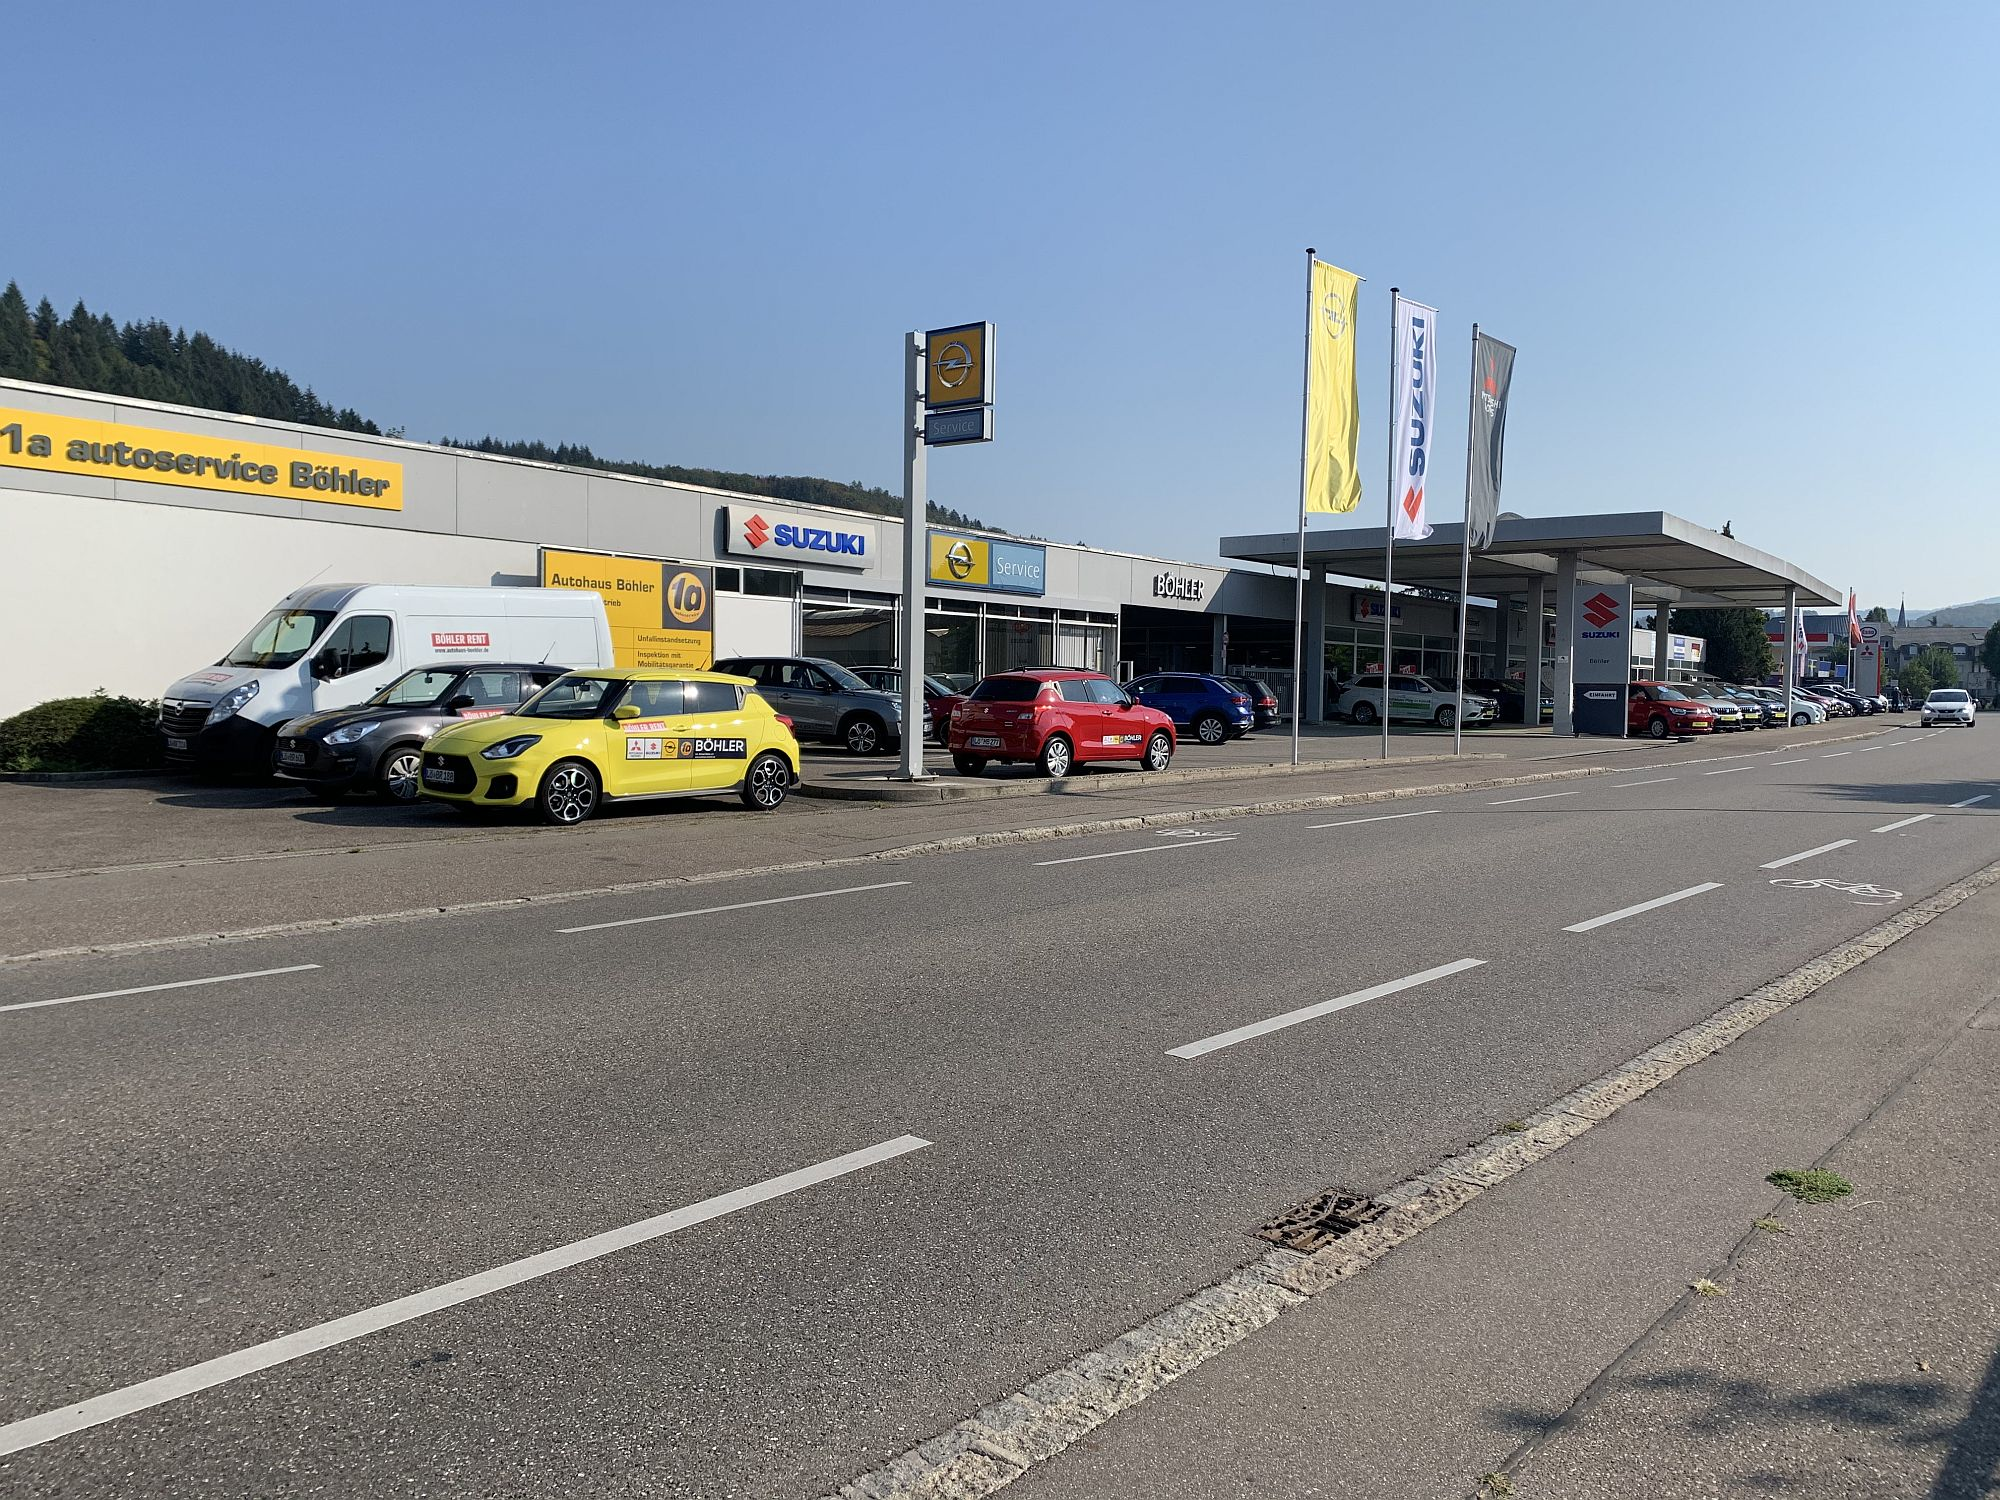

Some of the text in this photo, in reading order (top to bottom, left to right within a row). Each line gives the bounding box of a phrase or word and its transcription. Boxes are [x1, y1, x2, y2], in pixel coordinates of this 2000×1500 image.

[1409, 316, 1426, 477] SUZUKI
[933, 420, 976, 436] Service
[0, 423, 391, 498] 1a autoservice Böhler
[774, 523, 865, 556] SUZUKI
[997, 557, 1040, 579] Service
[551, 573, 655, 593] Autohaus Böhler
[1156, 571, 1205, 599] BÖHLER
[672, 577, 702, 612] 1a
[435, 633, 487, 646] BÖHLER RENT
[637, 634, 701, 646] Unfallinstandsetzung
[1581, 631, 1620, 639] SUZUKI
[637, 650, 670, 660] Inspektion
[695, 737, 744, 752] BÖHLER
